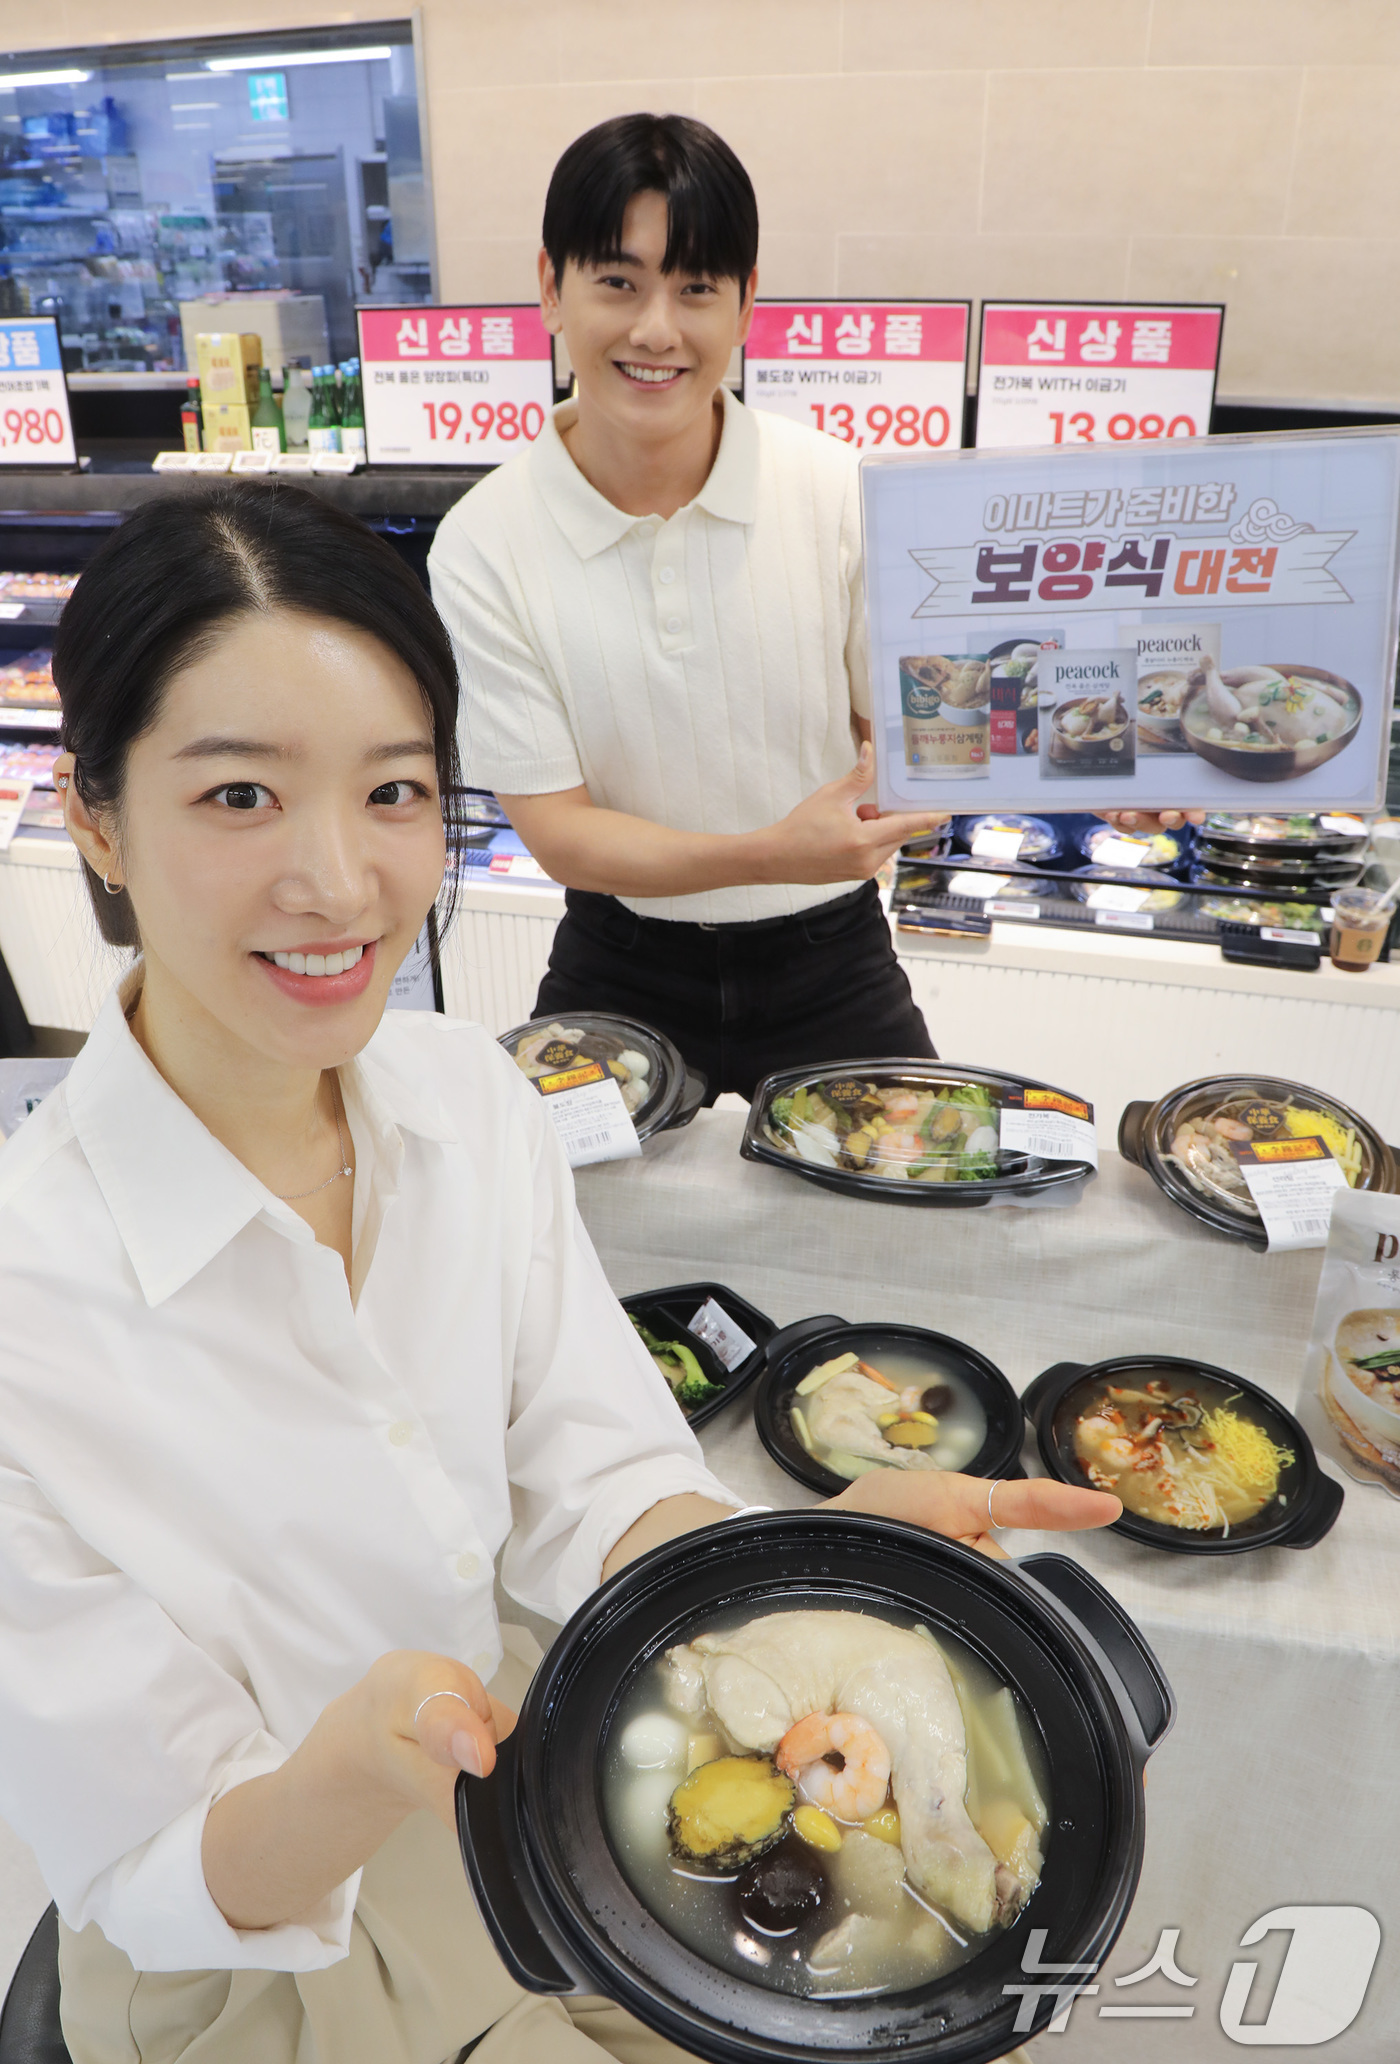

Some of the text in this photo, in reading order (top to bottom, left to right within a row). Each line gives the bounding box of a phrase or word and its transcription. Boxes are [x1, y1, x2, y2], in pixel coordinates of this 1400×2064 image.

[396, 316, 514, 356] 신상품
[786, 314, 922, 356] 신상품
[1026, 318, 1172, 363] 신상품
[756, 369, 882, 385] 불도장 WITH 이금기
[993, 375, 1127, 393] 전가복 WITH 이금기
[422, 402, 545, 444] 19,980
[810, 403, 950, 449] 13,980
[982, 482, 1237, 533] 이마트가 준비한
[971, 538, 1278, 604] 보양식 대전
[1136, 634, 1203, 656] peacock
[1055, 661, 1121, 683] peacock
[910, 693, 940, 706] bibigo
